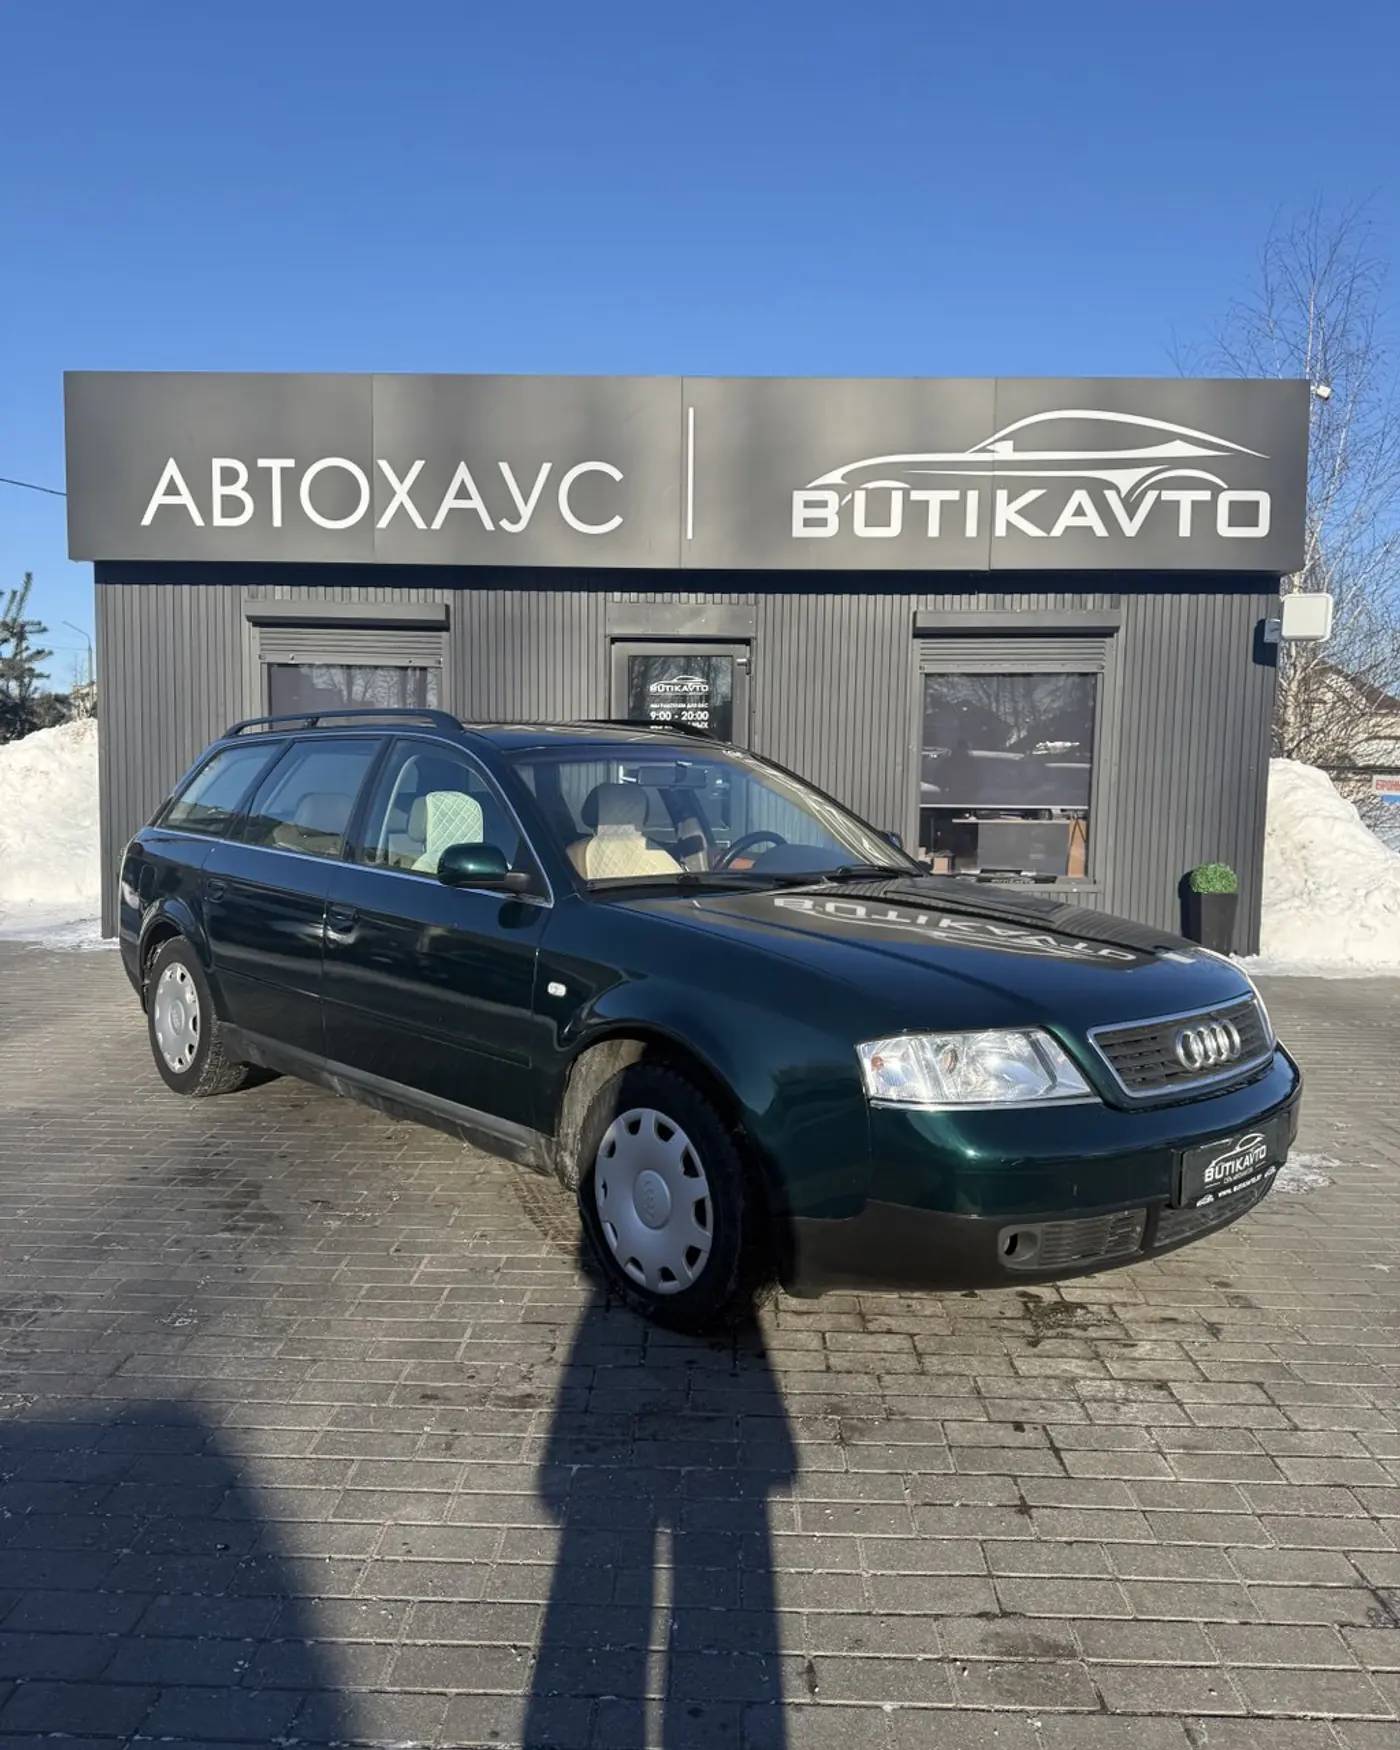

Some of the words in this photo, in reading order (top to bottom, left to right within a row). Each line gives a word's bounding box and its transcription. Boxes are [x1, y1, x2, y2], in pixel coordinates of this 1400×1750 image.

[140, 456, 624, 535] АВТОХАУС
[792, 488, 1271, 539] BUTIKAVTO
[649, 684, 709, 692] BUTIKAVTO
[650, 711, 672, 720] 9:00
[681, 711, 709, 720] 20:00
[1204, 1144, 1267, 1183] BUTIKAVTO
